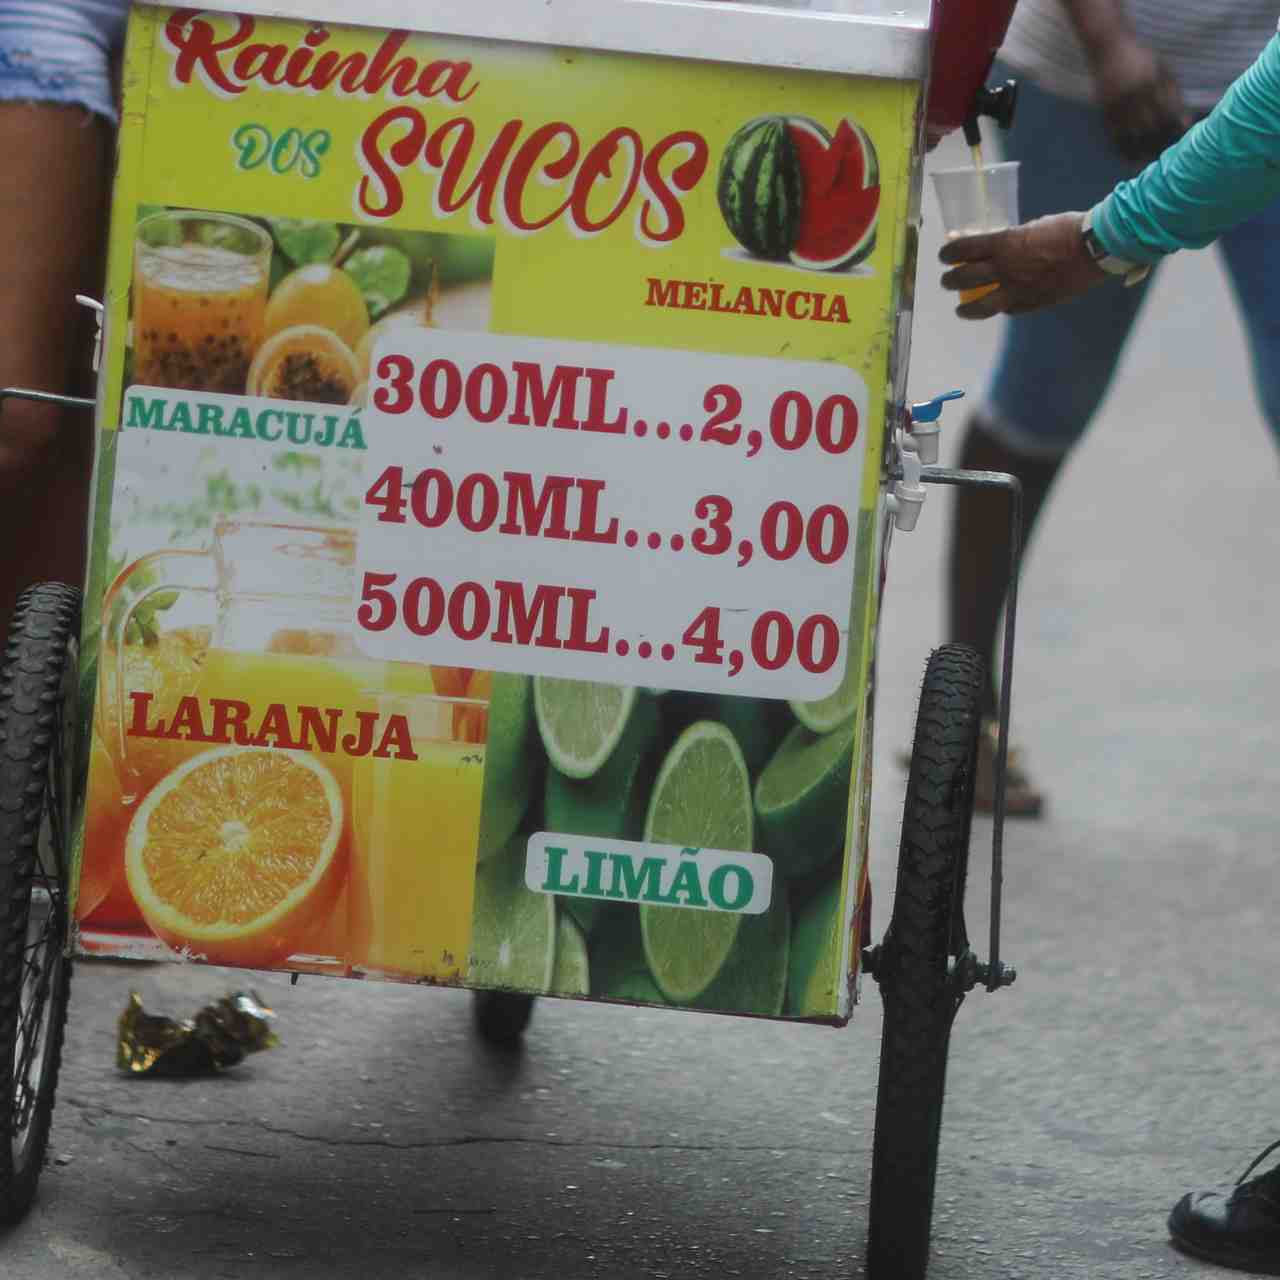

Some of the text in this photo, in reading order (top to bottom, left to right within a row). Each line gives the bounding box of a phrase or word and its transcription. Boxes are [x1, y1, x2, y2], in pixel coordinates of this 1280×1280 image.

[164, 9, 481, 103] Rainha
[233, 107, 709, 243] DOS SUCOS
[645, 278, 851, 324] MELANCIA
[124, 395, 369, 451] MARACUJÁ
[127, 692, 419, 762] LARANJA
[541, 845, 756, 913] LIMÃO
